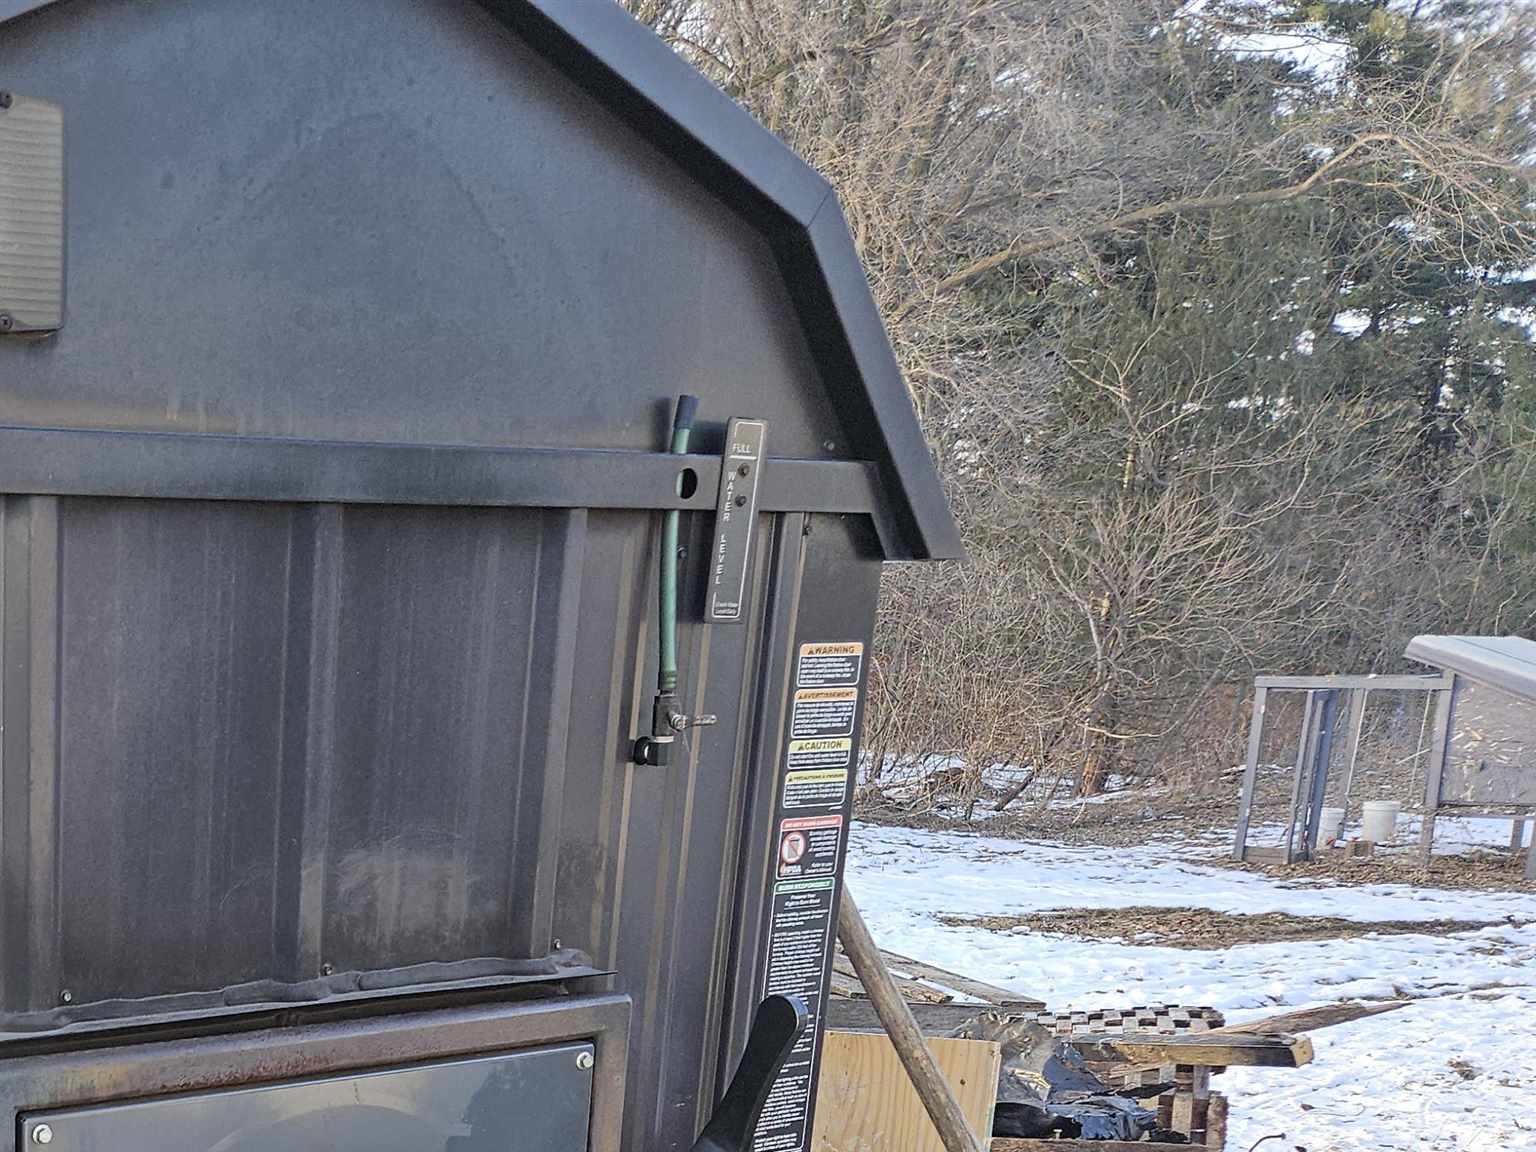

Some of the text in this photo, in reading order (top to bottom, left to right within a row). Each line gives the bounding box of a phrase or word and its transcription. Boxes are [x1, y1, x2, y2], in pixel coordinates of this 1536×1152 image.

[732, 443, 752, 454] FULL
[715, 471, 737, 585] WATER LEVEL
[815, 646, 855, 655] WARNING
[804, 740, 842, 750] CAUTION
